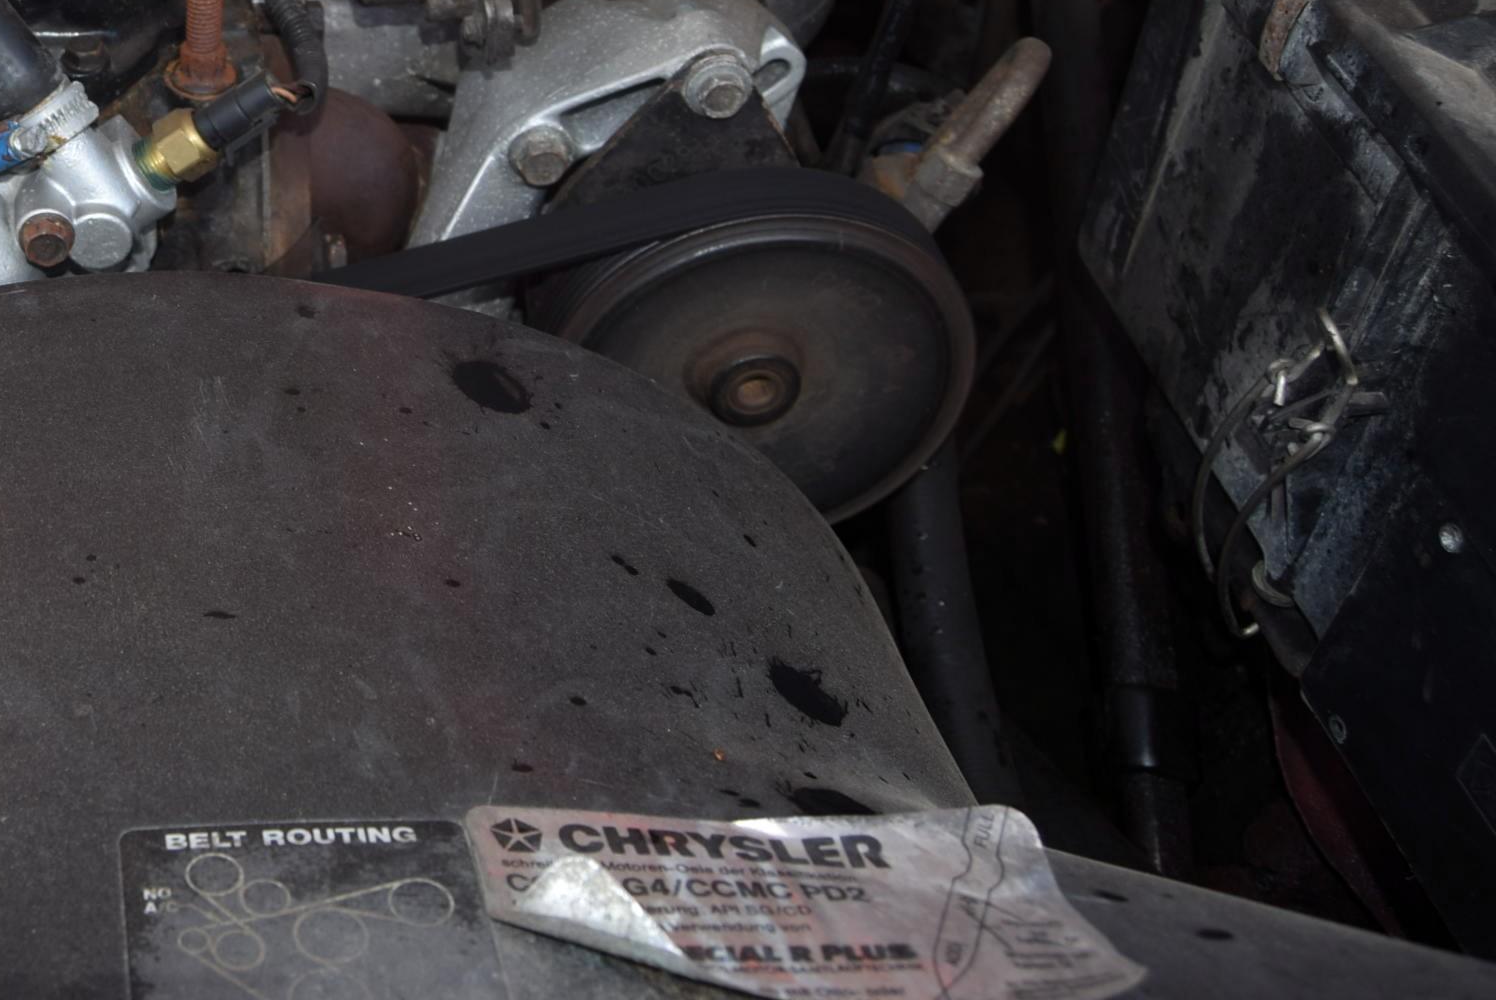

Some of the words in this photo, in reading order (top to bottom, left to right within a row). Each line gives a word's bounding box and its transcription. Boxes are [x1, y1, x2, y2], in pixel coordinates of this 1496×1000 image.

[164, 830, 247, 850] BELT
[262, 825, 417, 847] ROUTING
[972, 812, 995, 850] FULL
[557, 823, 892, 870] CHRYSLER
[799, 882, 872, 903] PD2
[820, 943, 917, 963] PLUS
